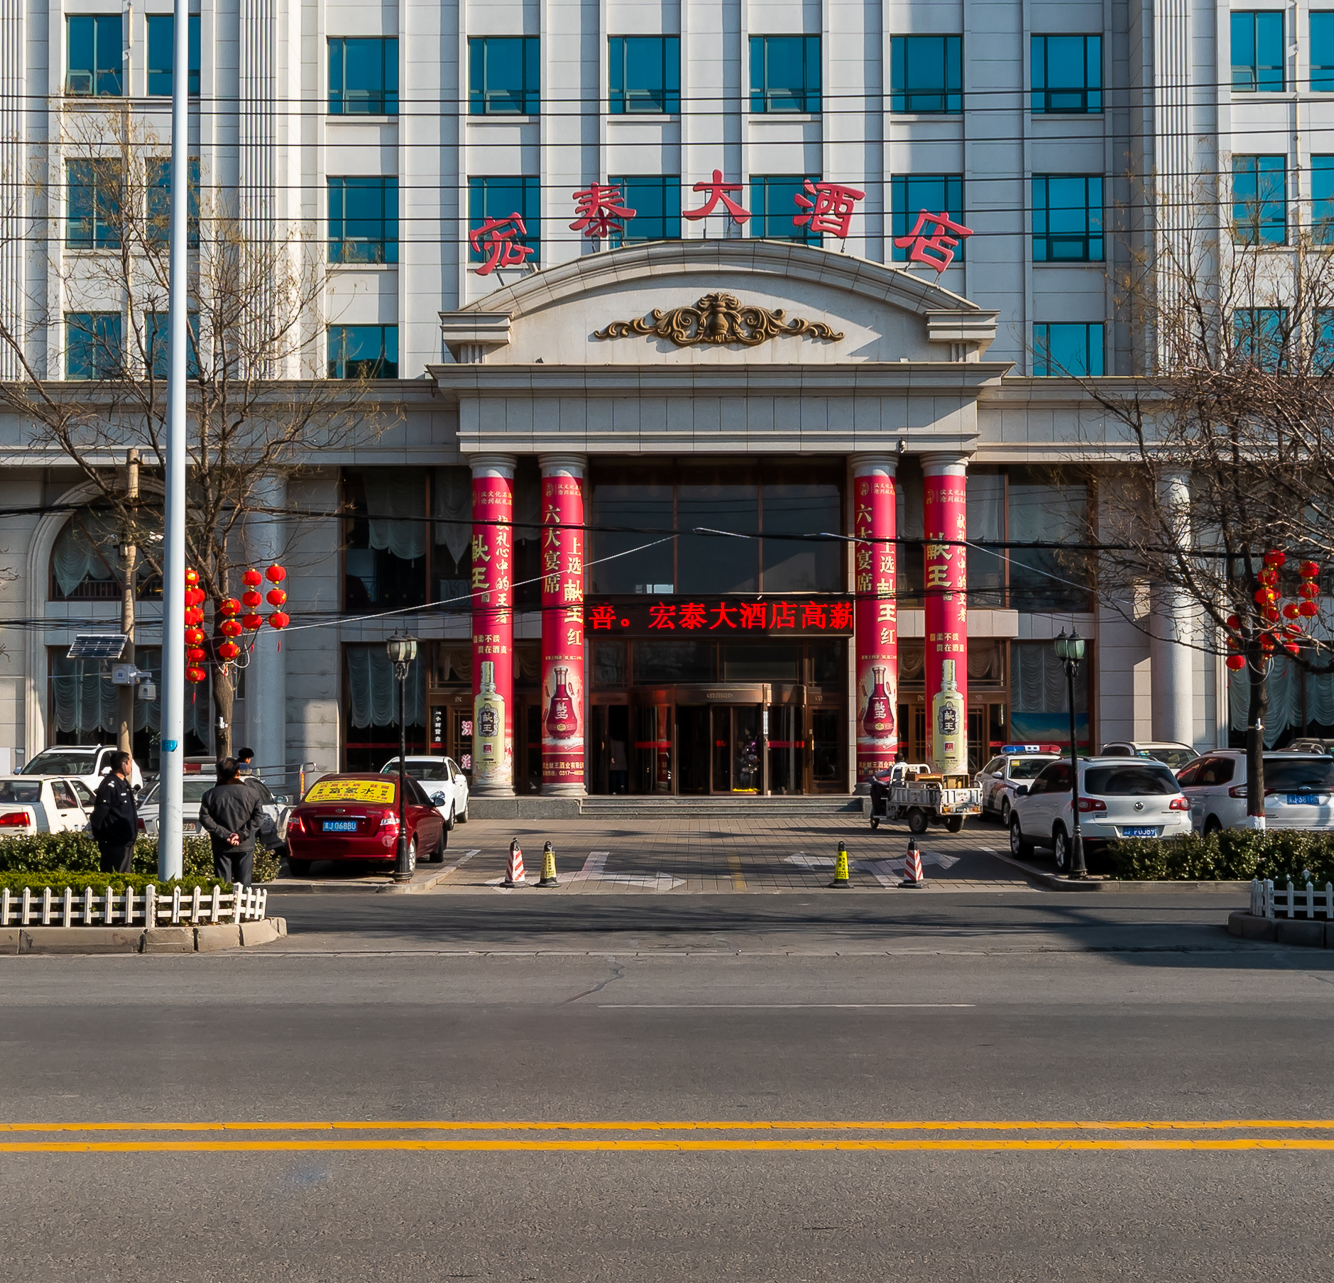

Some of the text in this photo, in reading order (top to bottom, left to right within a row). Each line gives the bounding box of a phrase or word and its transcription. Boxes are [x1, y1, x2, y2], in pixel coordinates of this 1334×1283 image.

[469, 169, 974, 276] 宏泰大酒店
[544, 504, 561, 594] 六大宴席
[856, 503, 873, 593] 六大宴席
